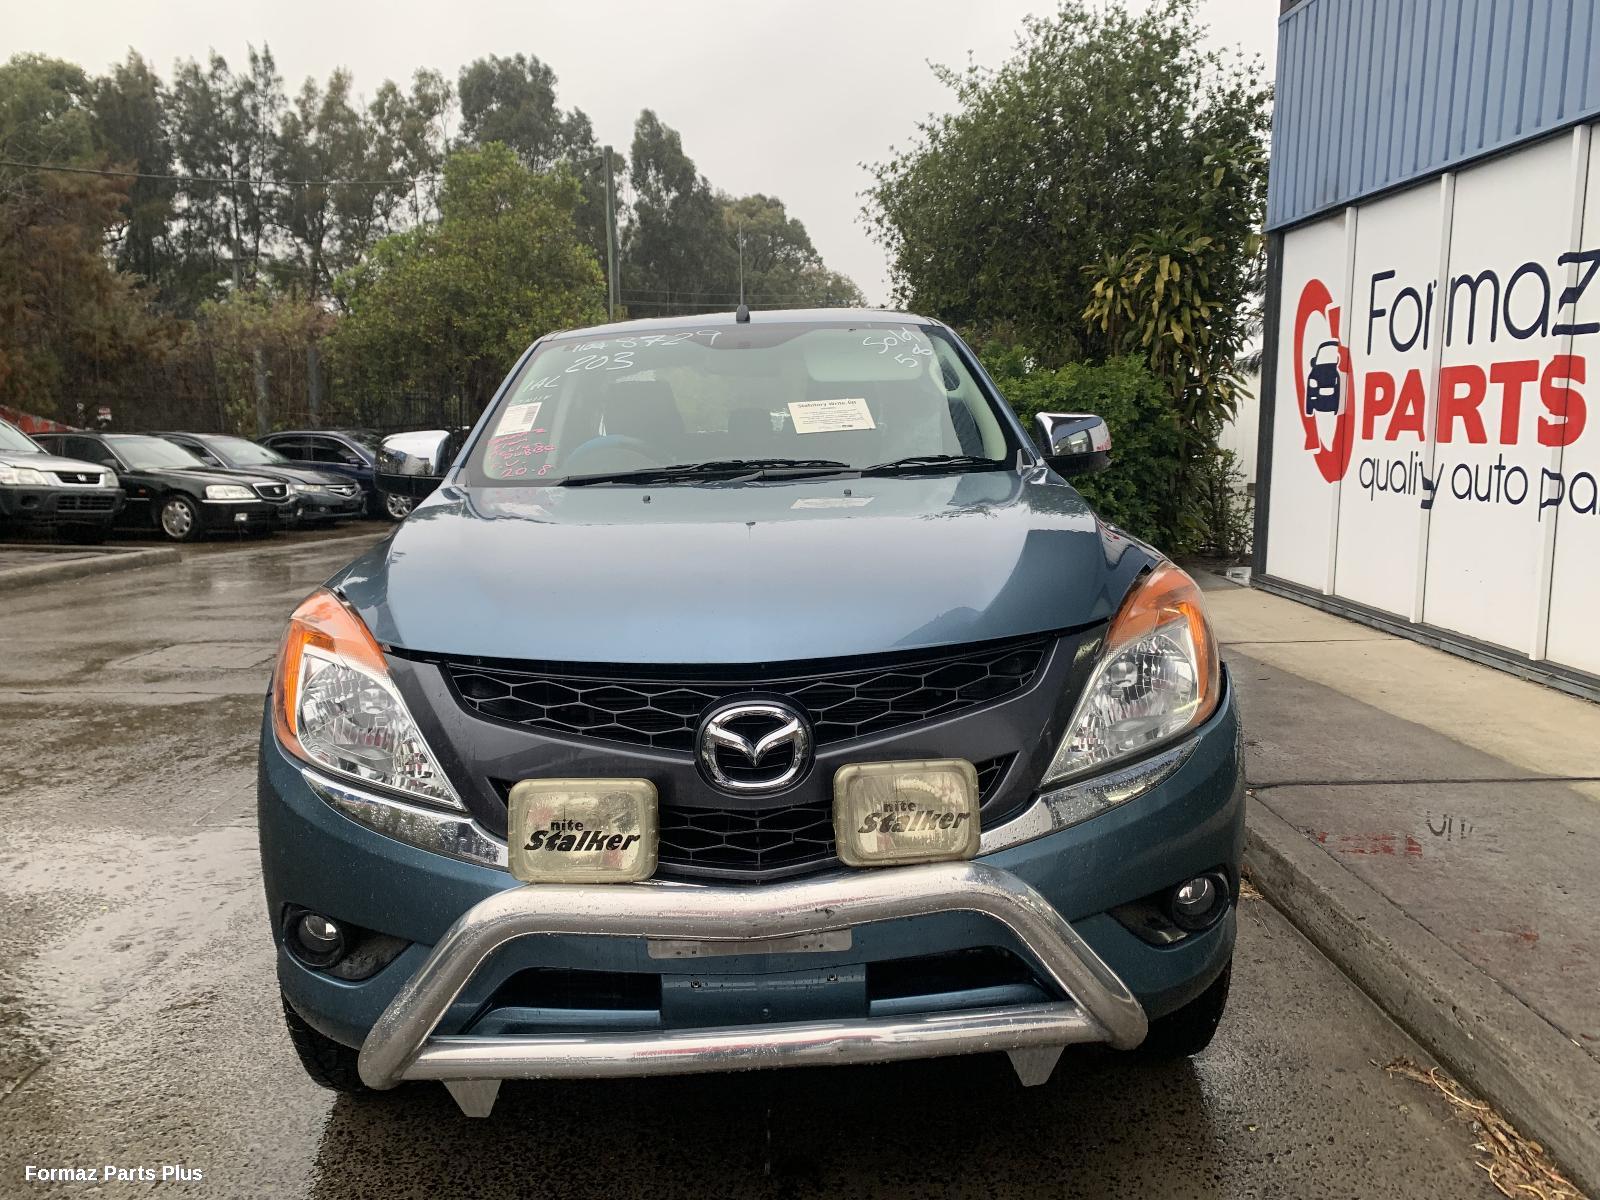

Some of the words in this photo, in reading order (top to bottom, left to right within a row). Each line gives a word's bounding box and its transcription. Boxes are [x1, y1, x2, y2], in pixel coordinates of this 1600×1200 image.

[1366, 249, 1600, 355] Formaz
[1361, 354, 1587, 447] PARTS
[1359, 451, 1444, 509] qualiy
[1451, 453, 1529, 505] auto
[1538, 467, 1600, 522] pa
[883, 800, 917, 812] nite
[550, 819, 584, 831] nite
[858, 809, 971, 834] Stalker
[524, 830, 641, 852] Stalker
